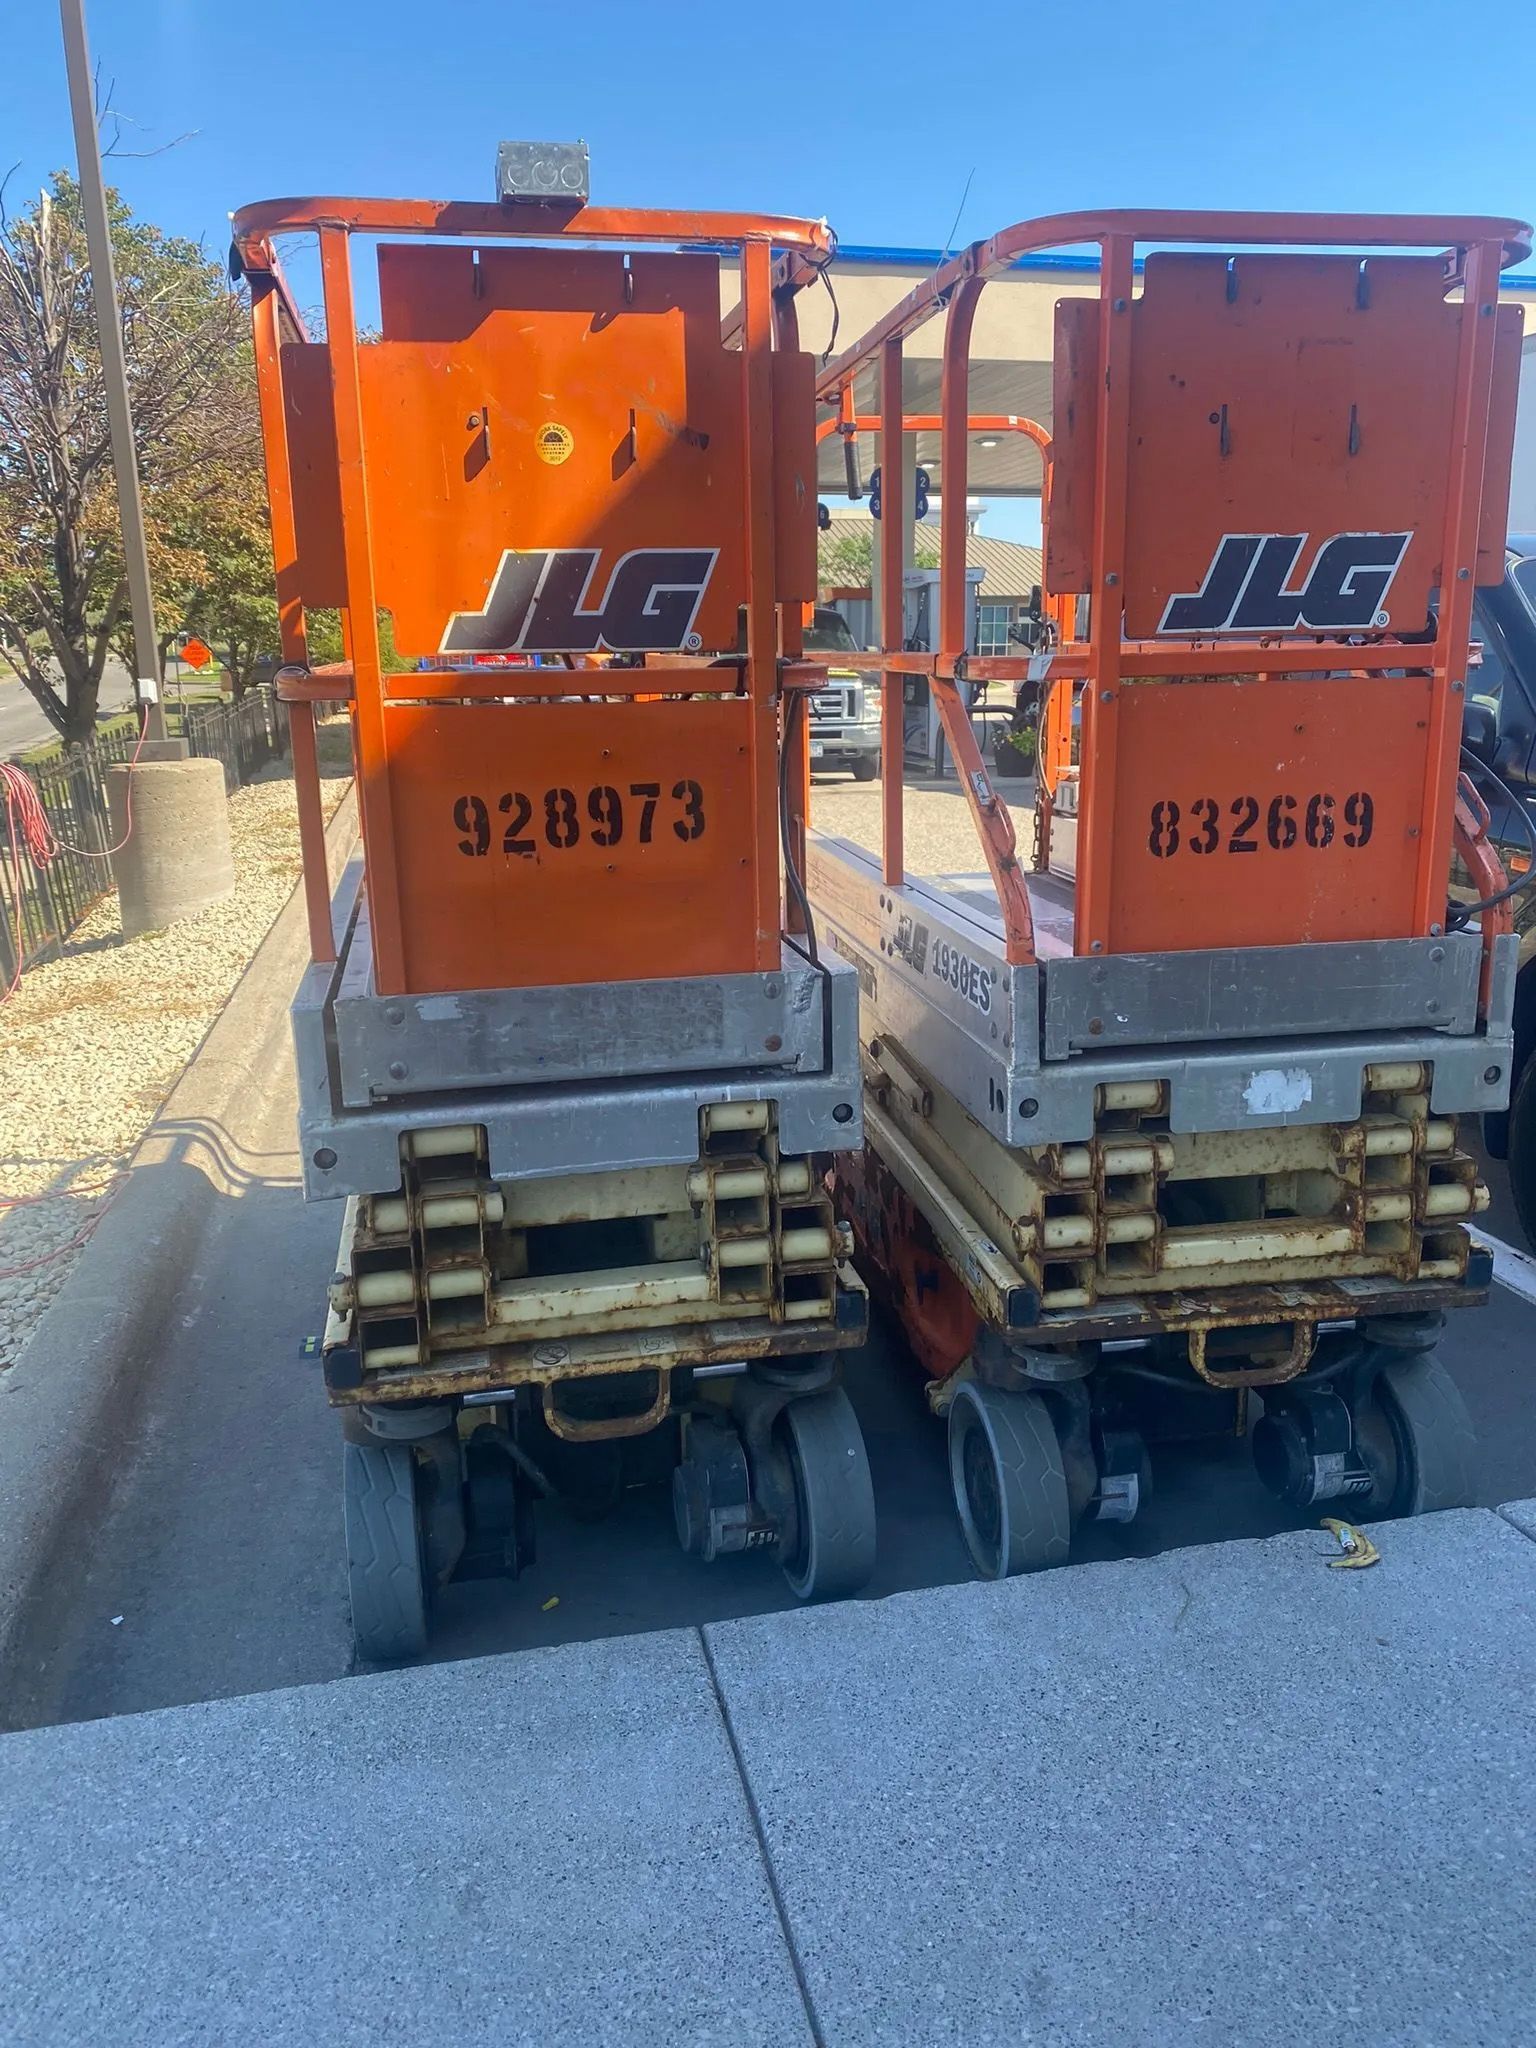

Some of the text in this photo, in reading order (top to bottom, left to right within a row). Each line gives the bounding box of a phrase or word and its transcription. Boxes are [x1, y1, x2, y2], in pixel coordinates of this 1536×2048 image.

[874, 477, 880, 487] 1
[874, 500, 880, 510] 3
[917, 500, 924, 510] 4
[919, 477, 926, 487] 2
[438, 548, 720, 653] JLG
[1156, 531, 1414, 634] JLG
[453, 780, 706, 857] 928973
[1149, 792, 1374, 858] 832669
[931, 936, 992, 1014] 1930ES
